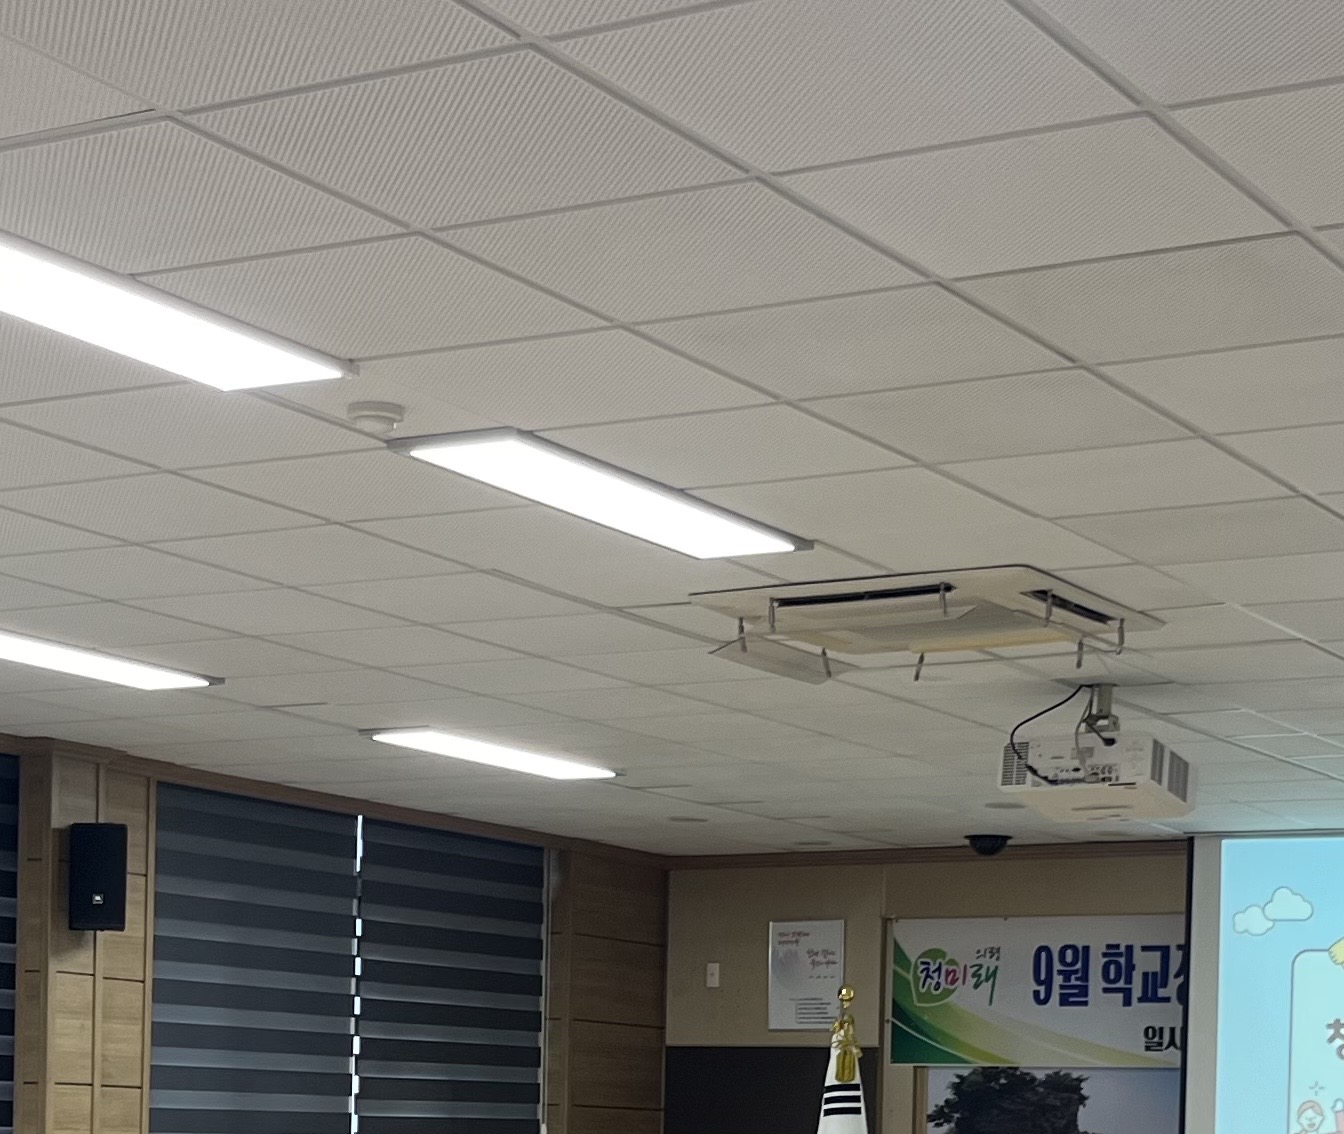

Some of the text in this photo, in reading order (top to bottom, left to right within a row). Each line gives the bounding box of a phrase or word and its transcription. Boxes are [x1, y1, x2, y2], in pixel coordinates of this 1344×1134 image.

[975, 946, 1001, 959] 의령
[918, 961, 999, 1006] 청미래
[1032, 944, 1090, 1007] 9월
